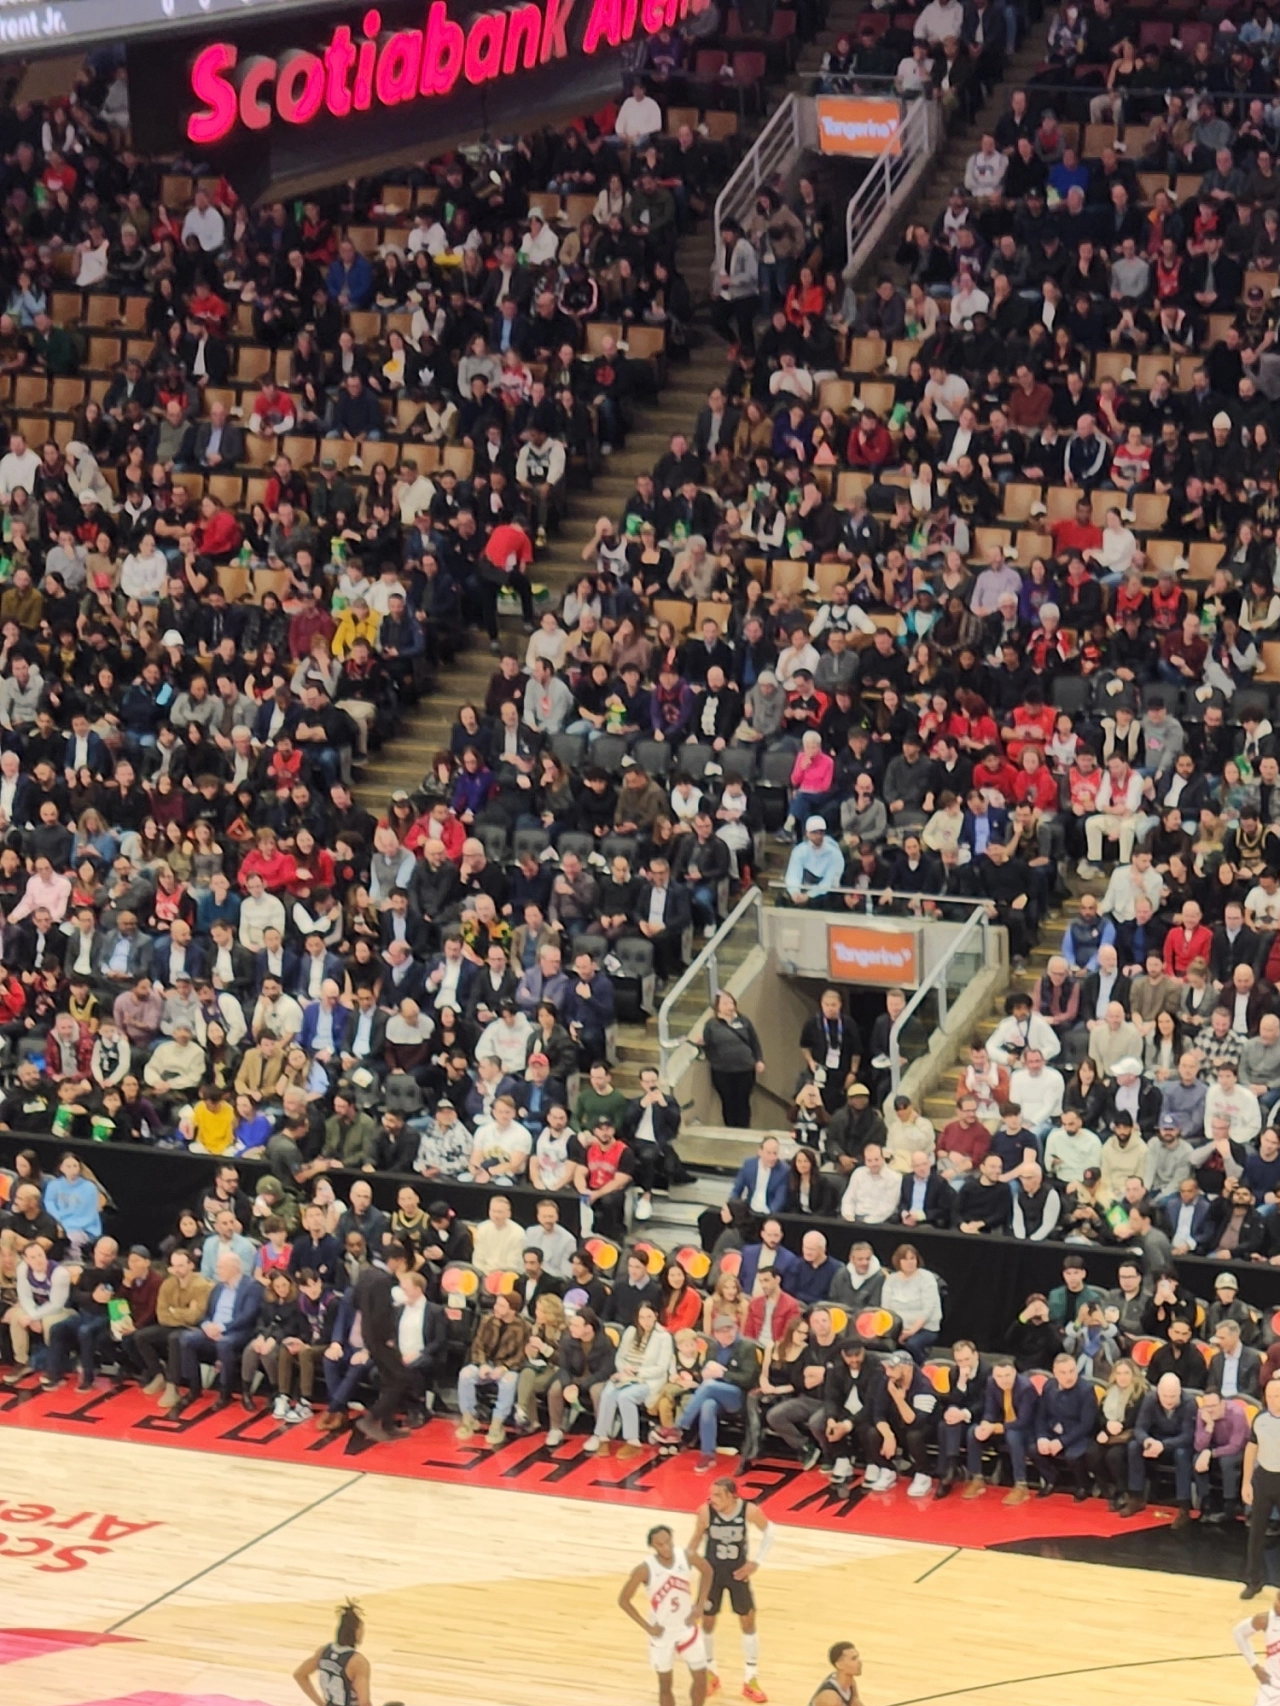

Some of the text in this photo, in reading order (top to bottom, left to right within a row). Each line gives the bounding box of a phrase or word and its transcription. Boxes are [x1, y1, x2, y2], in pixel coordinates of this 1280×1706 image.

[187, 0, 709, 143] Scotiabank Are
[0, 1532, 114, 1573] Sc
